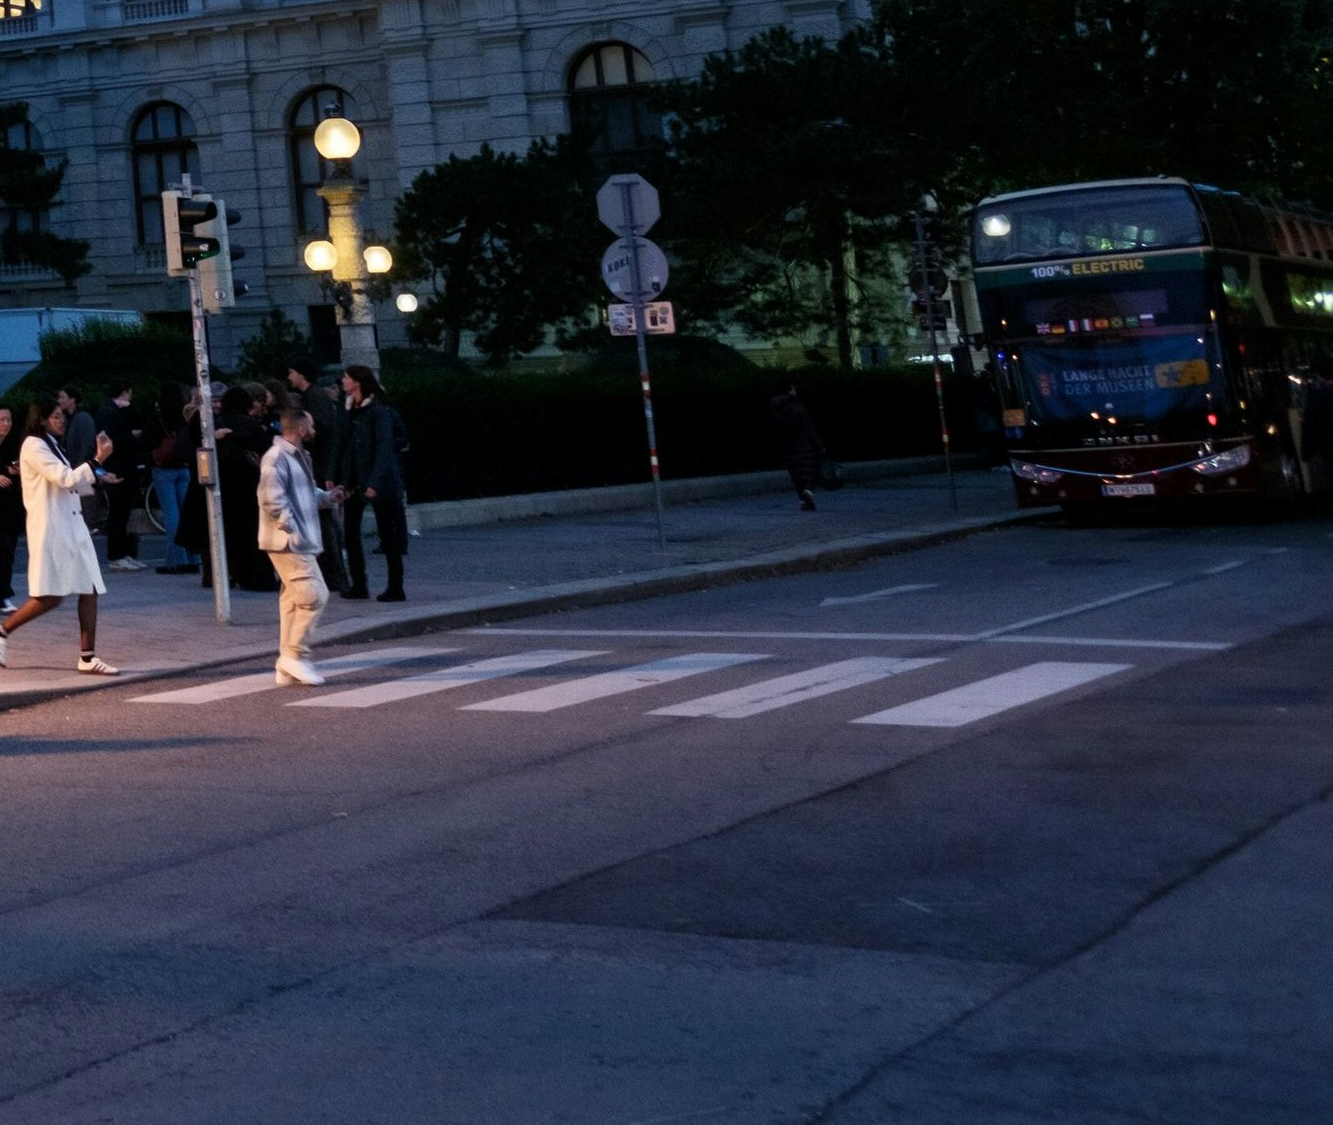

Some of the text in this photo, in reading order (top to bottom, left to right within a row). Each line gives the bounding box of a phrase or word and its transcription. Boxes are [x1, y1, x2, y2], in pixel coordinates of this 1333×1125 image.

[1031, 258, 1145, 279] 100% ELECTRIC
[1062, 368, 1105, 382] LANGE
[1106, 365, 1151, 379] NACHT
[1064, 377, 1156, 395] DER MUSEEN
